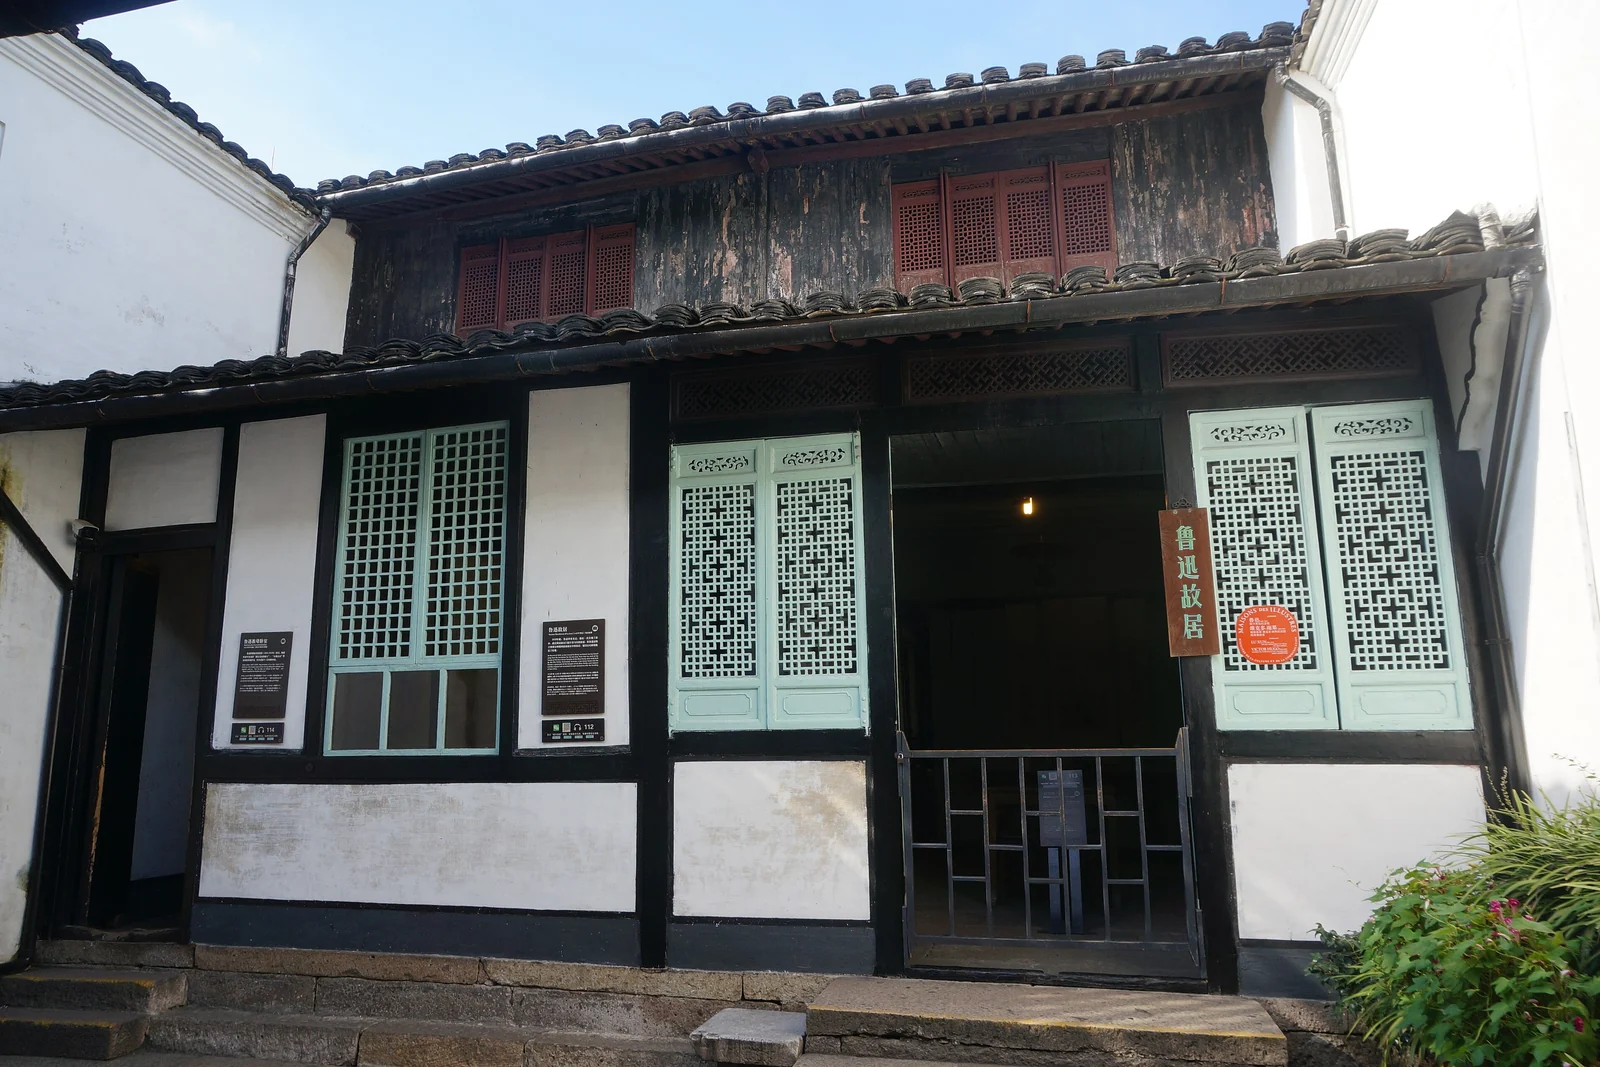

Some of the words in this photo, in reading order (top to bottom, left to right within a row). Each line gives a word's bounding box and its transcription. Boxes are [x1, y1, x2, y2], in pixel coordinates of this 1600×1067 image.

[1175, 525, 1204, 640] 鲁迅故居
[1238, 607, 1258, 634] MAISONS
[1270, 607, 1297, 633] ILLUSTRES
